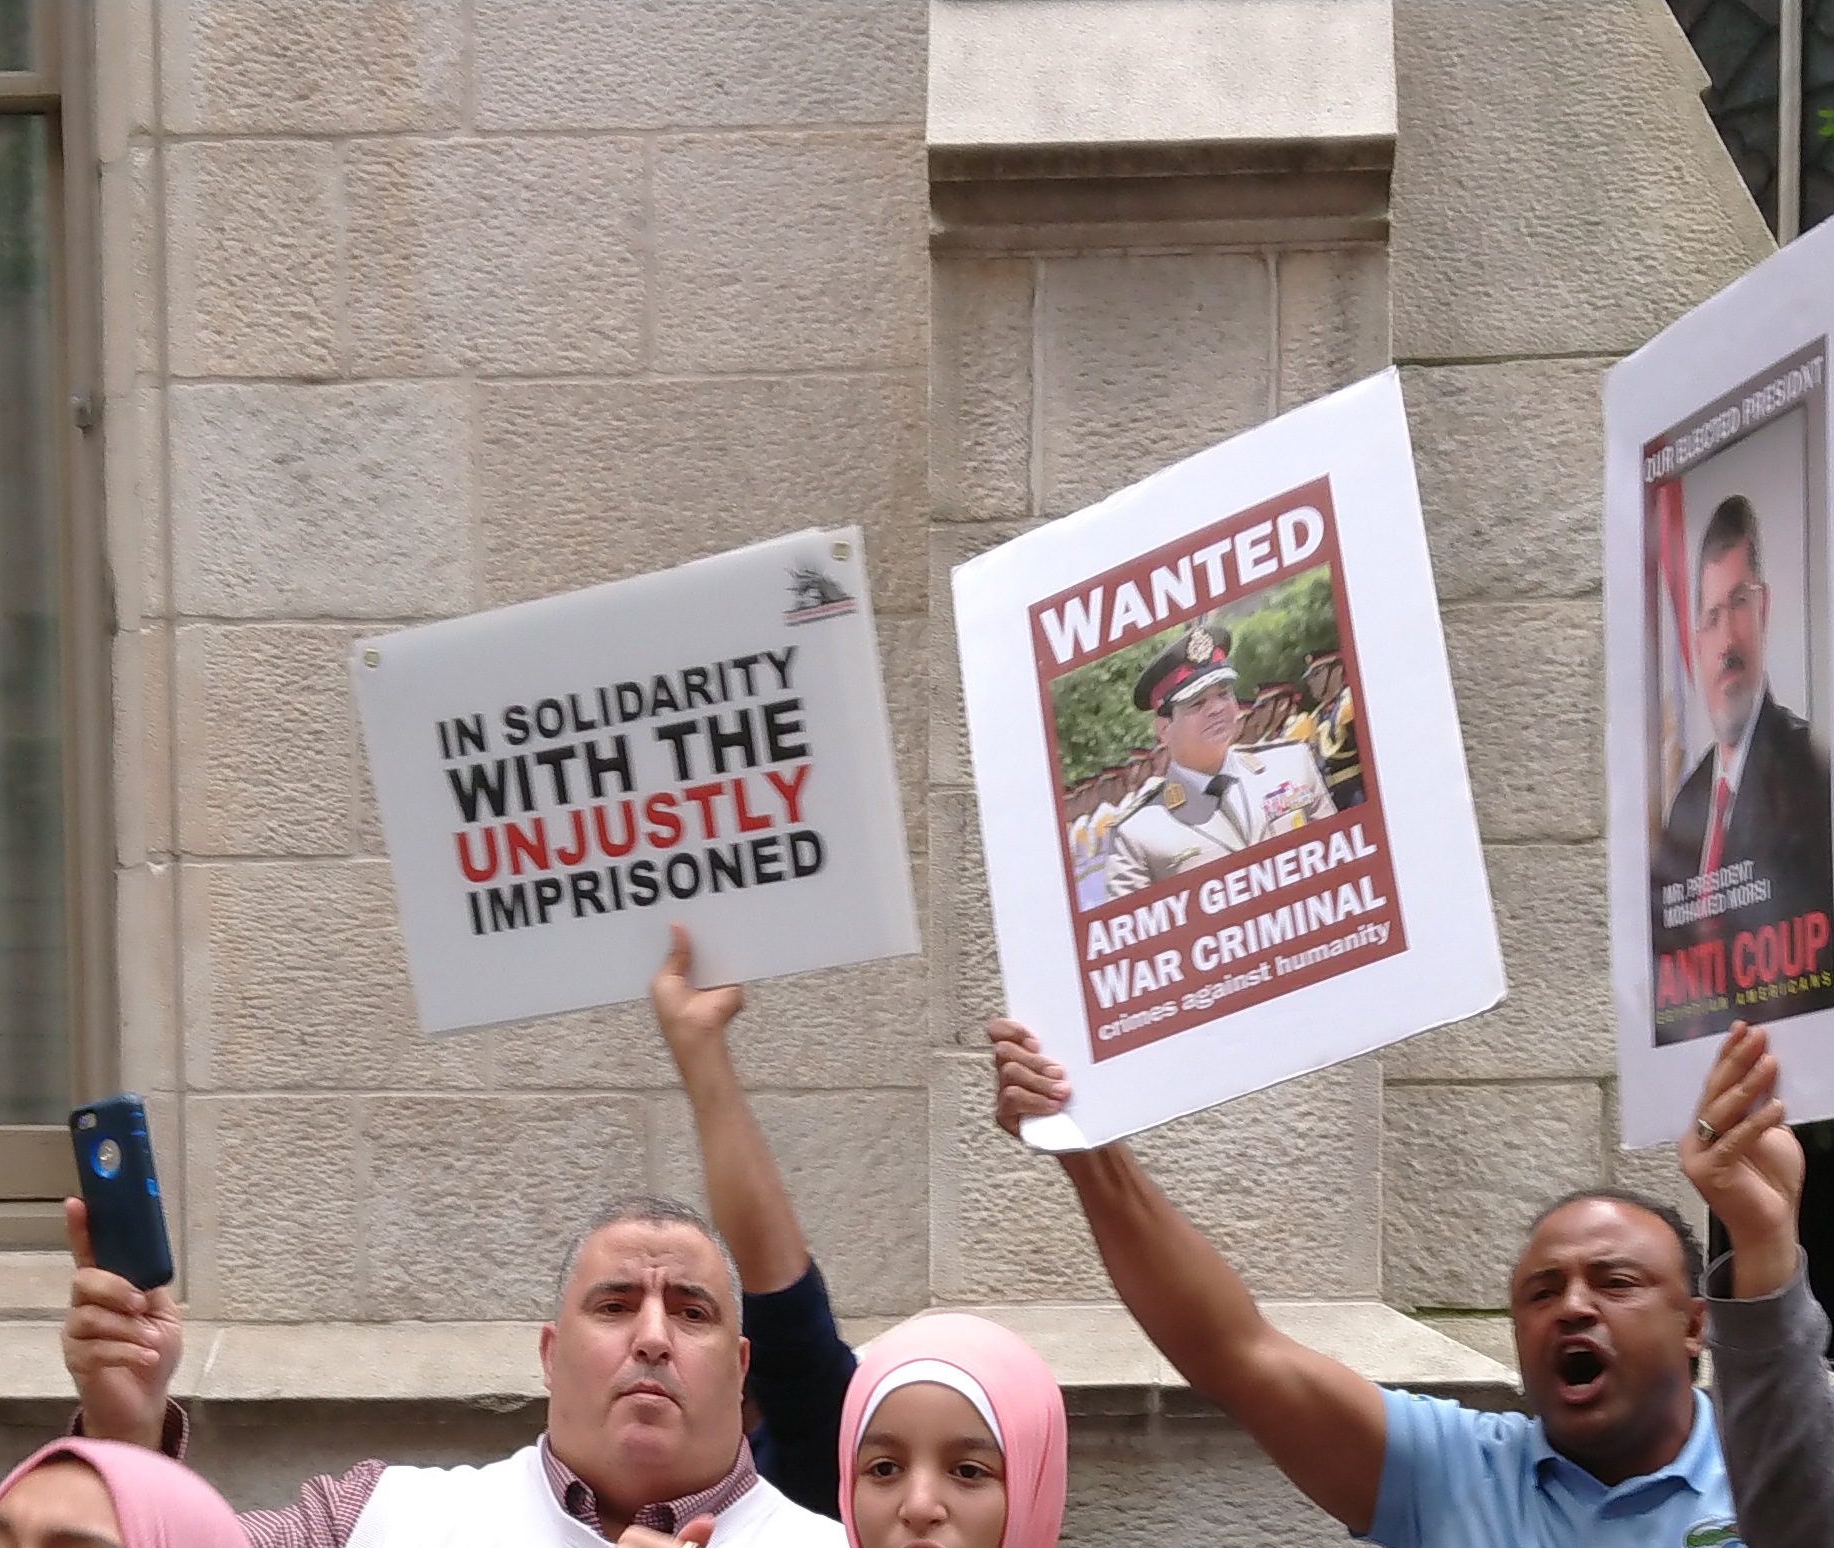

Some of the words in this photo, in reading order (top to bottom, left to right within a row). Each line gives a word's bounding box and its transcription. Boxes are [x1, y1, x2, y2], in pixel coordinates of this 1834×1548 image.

[1674, 406, 1741, 464] ELECTED
[1039, 505, 1325, 664] WANTED
[437, 713, 487, 759] IN
[502, 645, 799, 746] SOLIDARITY
[446, 734, 633, 823] WITH
[657, 697, 813, 782] THE
[453, 765, 812, 883] UNJUSTLY
[1686, 859, 1755, 900] PRESIDENT
[468, 830, 827, 935] IMPRISONED
[1087, 889, 1190, 961] ARMY
[1199, 823, 1377, 914] GENERAL
[1727, 877, 1771, 910] MORSI
[1088, 949, 1185, 1009] WAR
[1190, 875, 1387, 972] CRIMINAL
[1098, 999, 1178, 1040] crimes
[1181, 962, 1273, 1011] against
[1276, 920, 1391, 976] humanity
[1656, 938, 1728, 1008] ANTI
[1732, 910, 1830, 988] COUP
